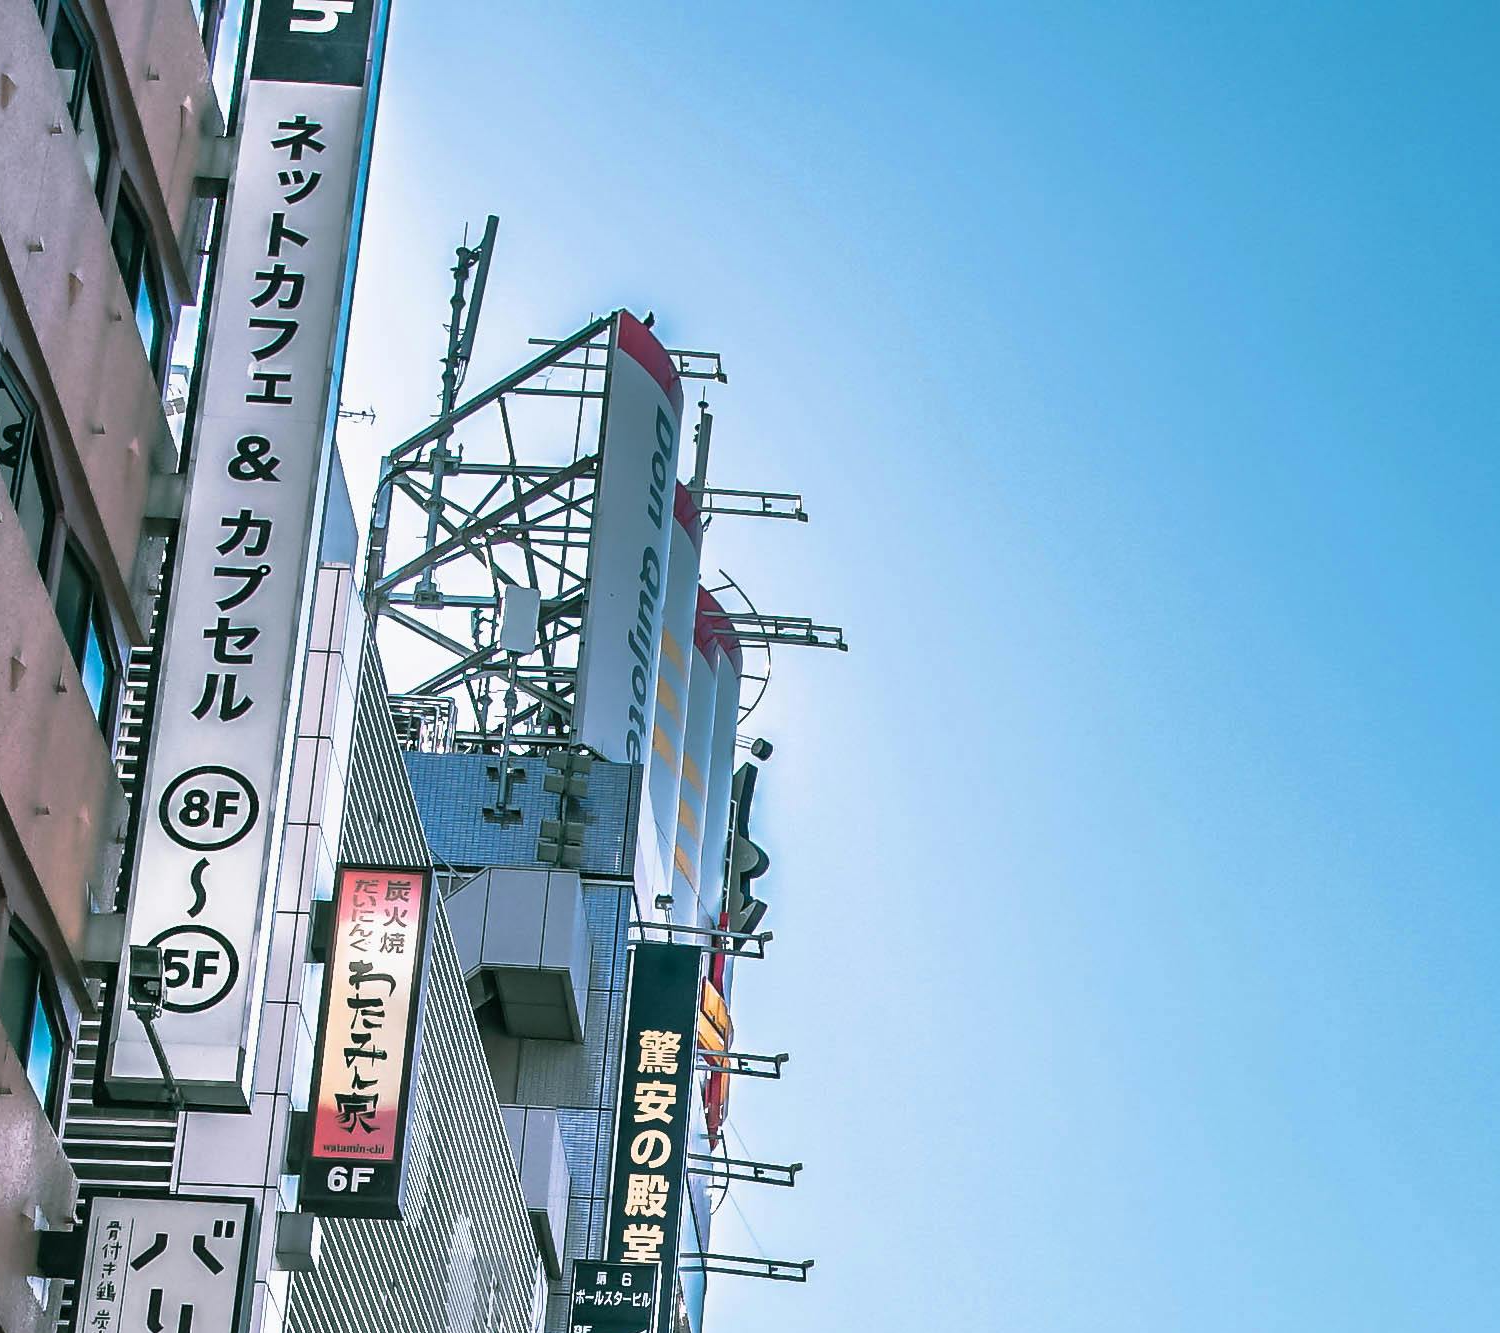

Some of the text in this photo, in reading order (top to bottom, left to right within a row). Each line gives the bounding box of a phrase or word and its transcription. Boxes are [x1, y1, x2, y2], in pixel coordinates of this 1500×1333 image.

[164, 115, 327, 989] ネットカフェ & カプセル 8F 5F
[380, 880, 411, 955] 炭火焼
[334, 959, 397, 1135] わたみん家
[327, 1166, 375, 1193] 6F
[622, 1030, 682, 1265] 驚安の殿堂
